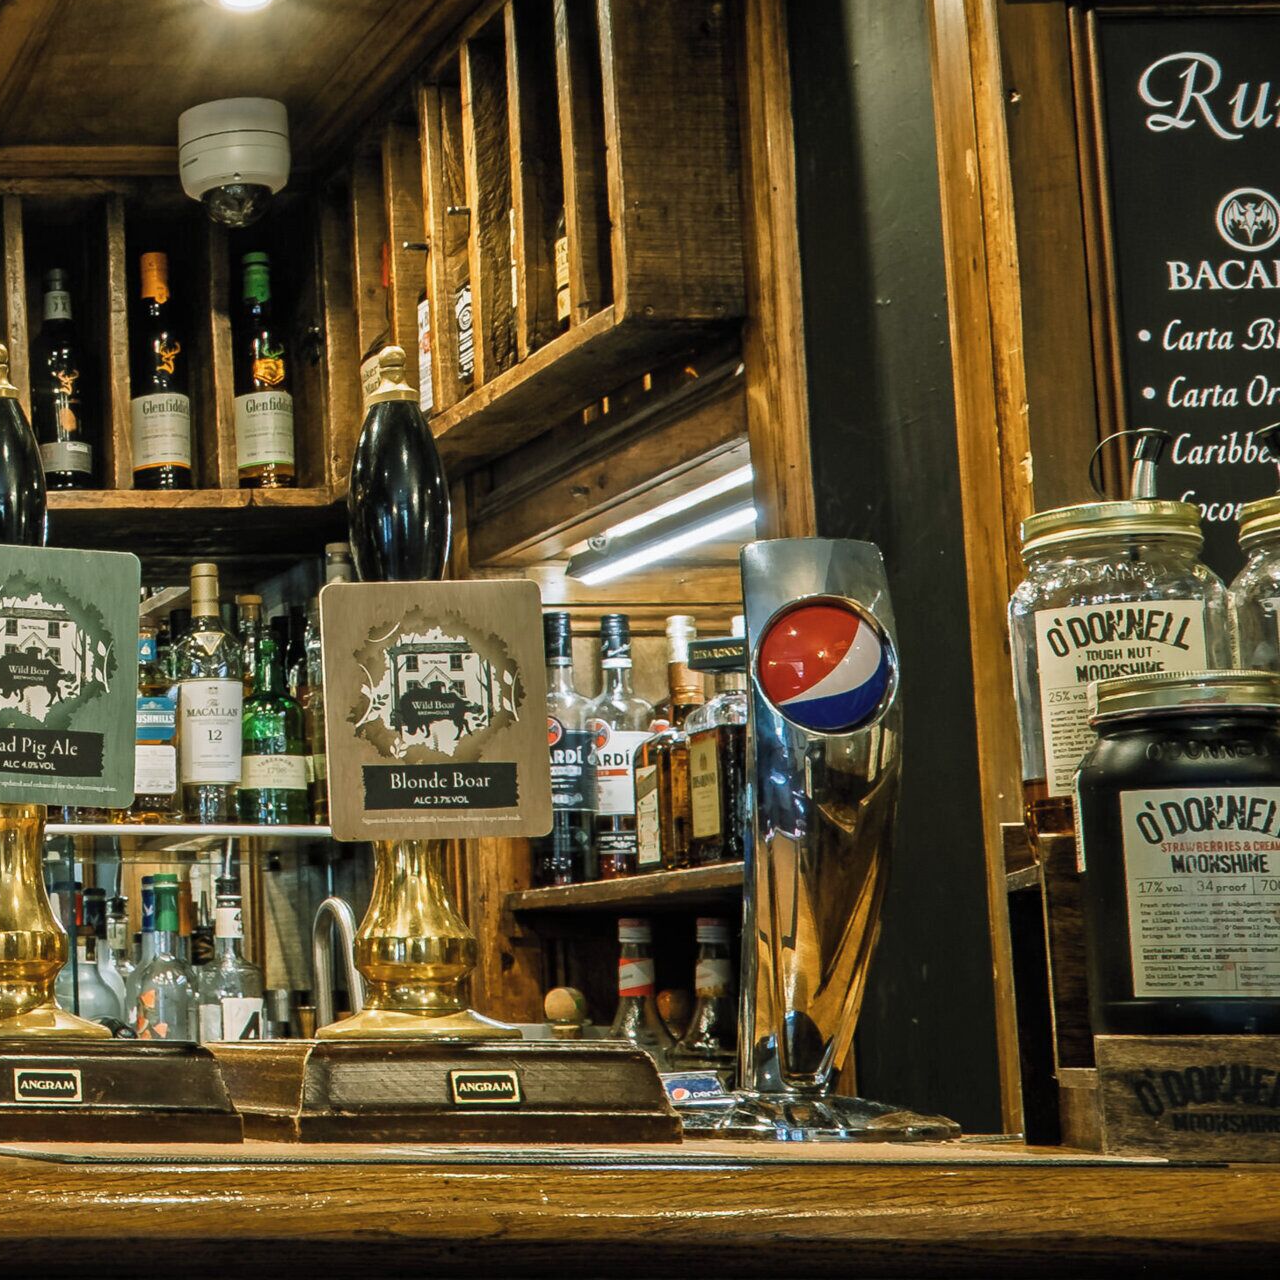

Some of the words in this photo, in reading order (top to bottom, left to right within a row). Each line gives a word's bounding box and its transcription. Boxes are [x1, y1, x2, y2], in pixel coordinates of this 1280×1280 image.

[1162, 319, 1234, 351] Carta
[1168, 375, 1238, 408] Carta
[1047, 608, 1191, 658] O'DONNELL
[1086, 649, 1123, 661] TOUGH
[1127, 647, 1152, 658] NUT
[8, 665, 28, 675] Wild
[30, 666, 50, 676] Boar
[1049, 691, 1070, 703] 25%
[1073, 692, 1087, 700] vol
[412, 700, 434, 710] Wild
[435, 700, 455, 710] Boar
[187, 709, 238, 717] MACALLAN
[208, 730, 222, 740] 12
[22, 737, 46, 760] Pig
[51, 738, 78, 756] Ale
[39, 762, 56, 770] VOL
[390, 771, 447, 789] Blonde
[453, 772, 491, 788] Boar
[414, 796, 431, 804] ALC
[1161, 841, 1241, 852] STRAWBERRIES
[1243, 841, 1251, 851] &
[1171, 854, 1270, 873] MOONSHINE
[1139, 882, 1164, 893] 17%
[1197, 880, 1213, 892] 34
[1216, 884, 1247, 893] proof
[20, 1080, 74, 1089] ANGRAM
[458, 1082, 513, 1093] ANGRAM
